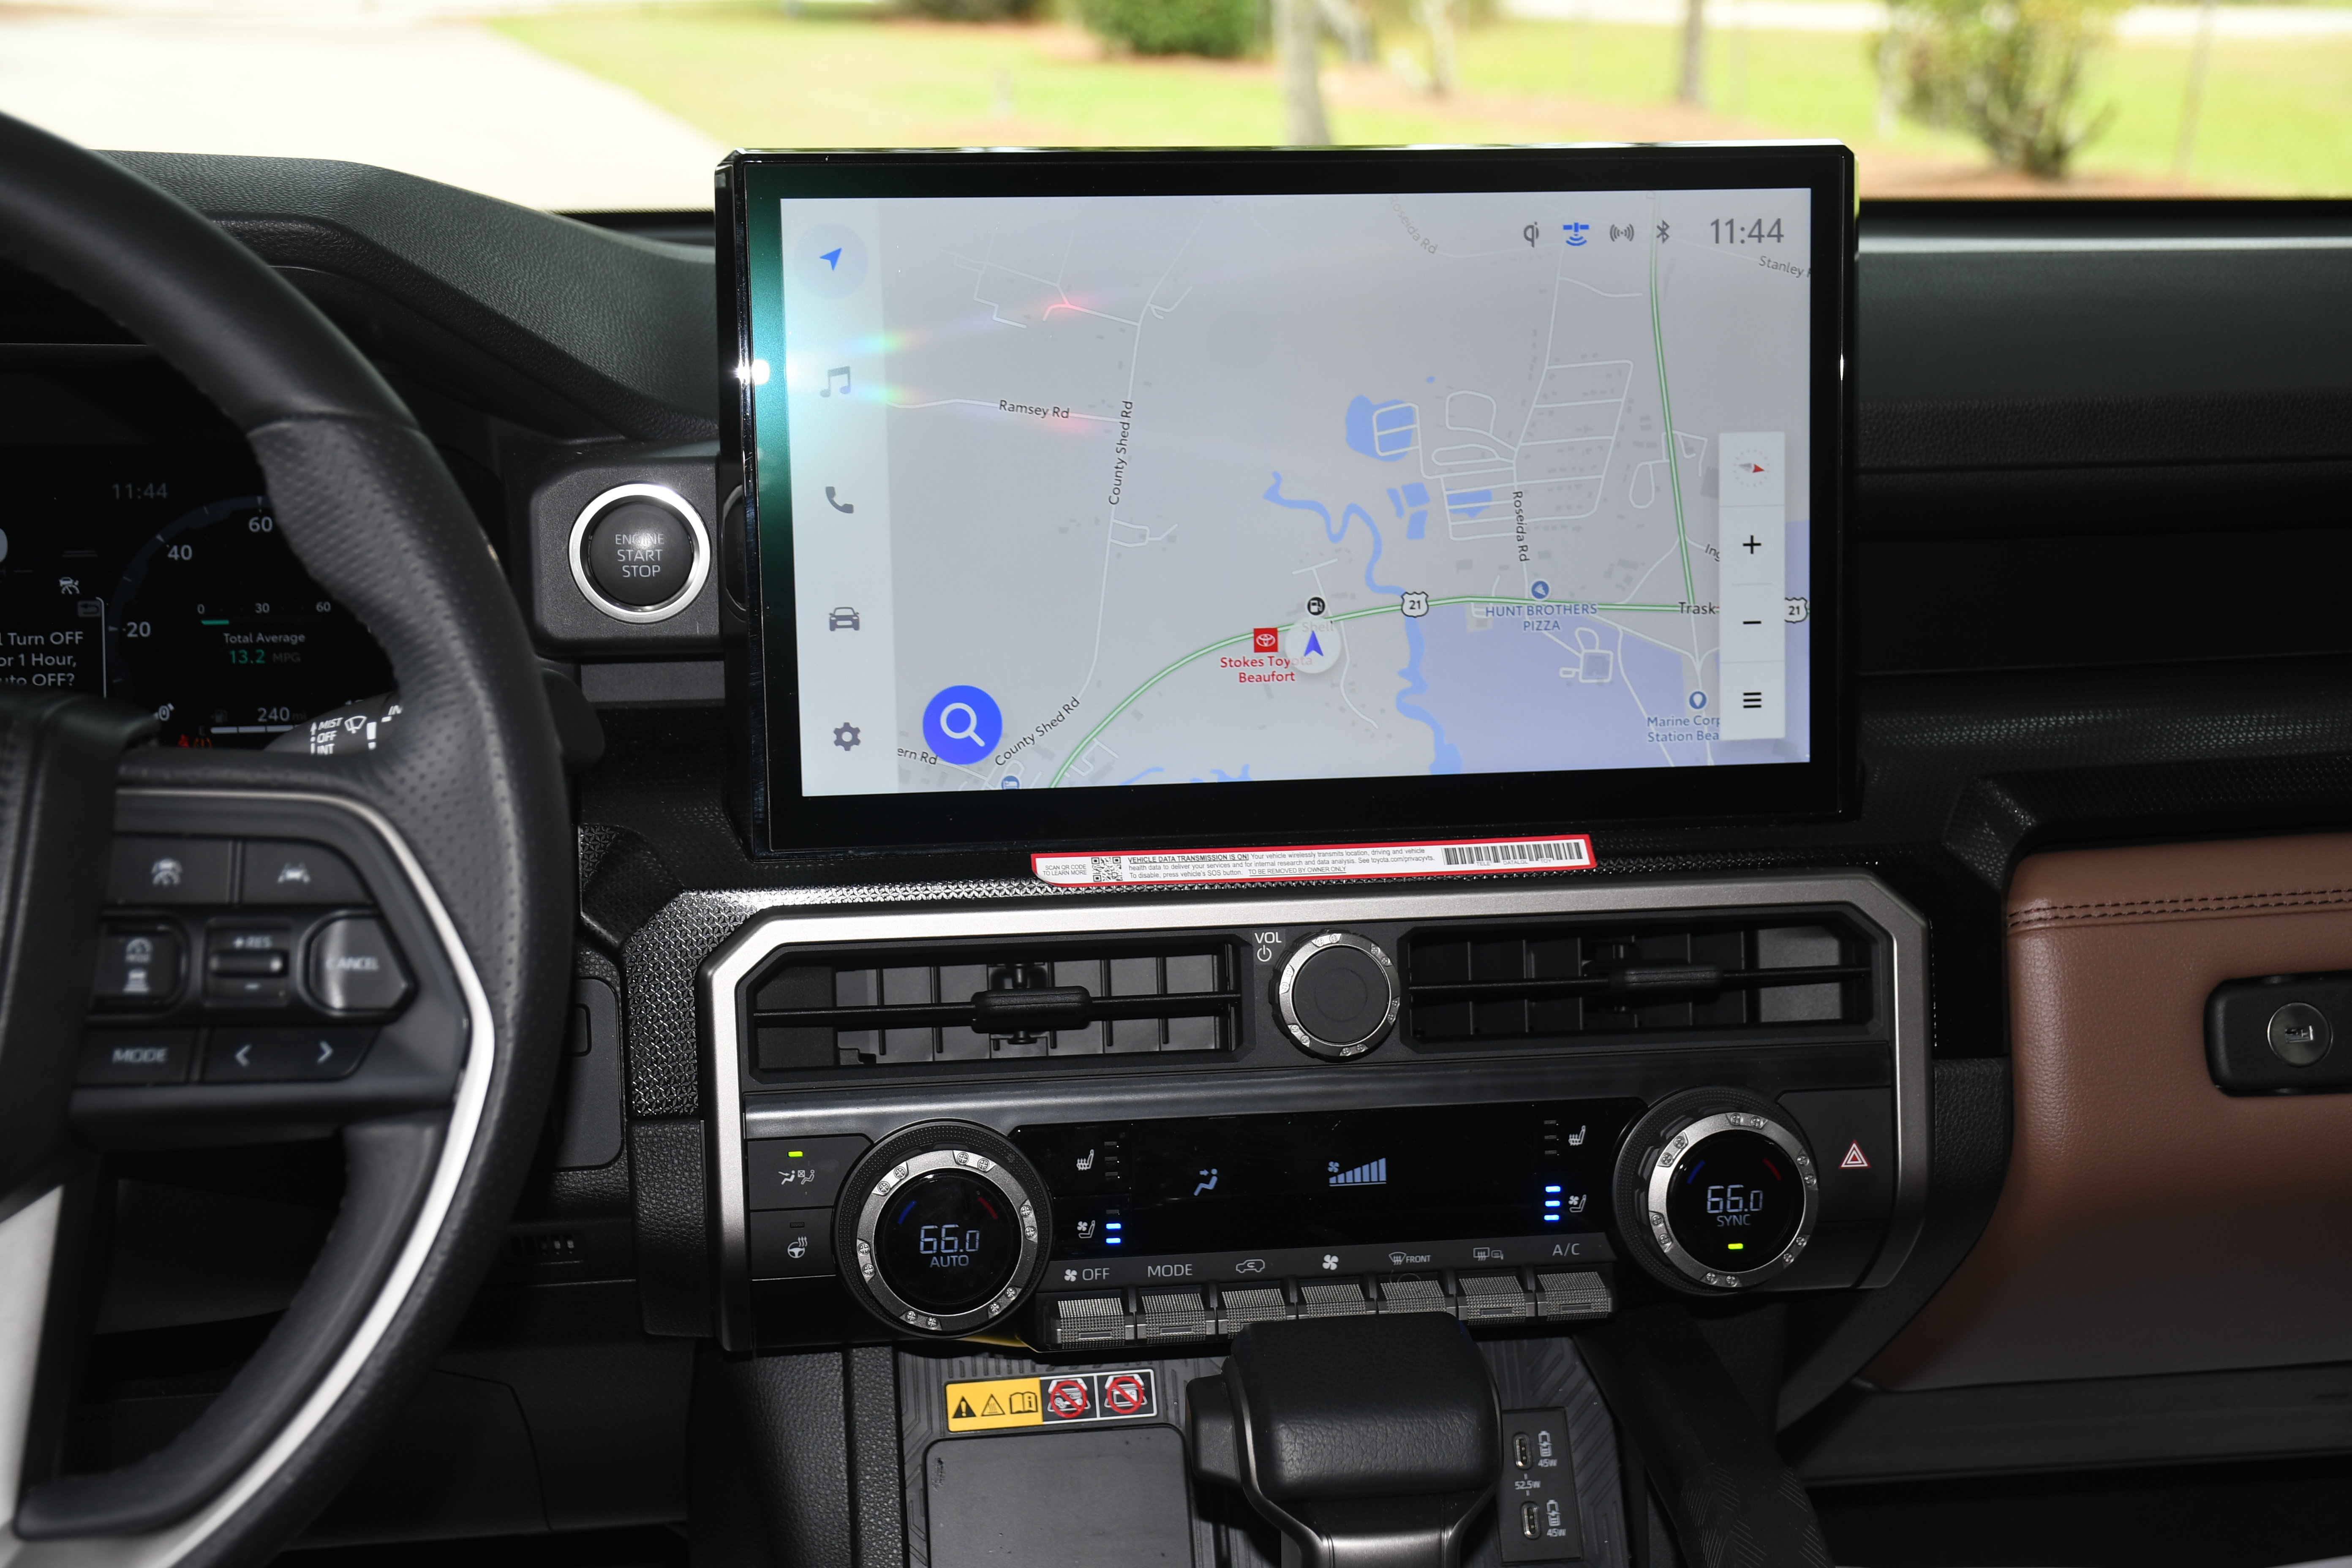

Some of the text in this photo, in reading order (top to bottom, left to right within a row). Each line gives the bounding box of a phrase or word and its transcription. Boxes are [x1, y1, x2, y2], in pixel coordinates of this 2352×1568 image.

[1710, 218, 1784, 244] 11:44
[1421, 238, 1438, 253] Rd
[1759, 256, 1804, 278] Stanley
[999, 400, 1070, 419] Ramsey Rd
[1109, 400, 1133, 505] County Shed Rd
[112, 483, 168, 499] 11:44
[248, 516, 273, 532] 60
[1513, 491, 1530, 562] Roseida Rd
[615, 534, 664, 544] ENGINE
[168, 545, 192, 561] 40
[617, 549, 663, 561] START
[622, 565, 661, 577] STOP
[197, 602, 331, 614] 0 30 60
[1409, 600, 1421, 610] 21
[1486, 604, 1597, 617] HUNT BROTHERS
[1678, 602, 1715, 614] Trask
[1788, 606, 1800, 615] 21
[127, 622, 151, 637] 20
[1302, 621, 1334, 632] Shell
[1524, 621, 1560, 631] PIZZA
[8, 632, 44, 645] Turn
[50, 632, 84, 645] OFF
[223, 633, 306, 645] Total Average
[19, 654, 25, 666] 1
[32, 653, 76, 667] Hour,
[230, 649, 301, 664] 13.2 MPG
[1220, 656, 1312, 668] Stokes Toyota
[32, 673, 75, 686] OFF?
[1239, 670, 1296, 683] Beaufort
[257, 707, 290, 721] 240
[318, 717, 343, 731] MIST
[1647, 716, 1689, 727] Marine
[317, 730, 337, 743] OFF
[995, 696, 1080, 766] County Shed Rd
[1648, 730, 1719, 742] Station Bea
[317, 743, 335, 755] INT
[920, 752, 938, 765] Rd
[1254, 931, 1282, 944] VOL
[325, 956, 380, 971] CANCEL
[112, 1047, 168, 1063] MODE
[1706, 1184, 1763, 1214] 66.0
[1716, 1214, 1751, 1227] SYNC
[919, 1224, 980, 1254] 66.0
[1552, 1243, 1580, 1256] A/C
[930, 1255, 969, 1267] AUTO
[1405, 1254, 1431, 1263] FRONT
[1082, 1268, 1110, 1280] OFF
[1147, 1264, 1192, 1277] MODE
[1538, 1459, 1558, 1467] 45W
[1514, 1480, 1541, 1490] 52.5W
[1546, 1528, 1566, 1537] 45W
